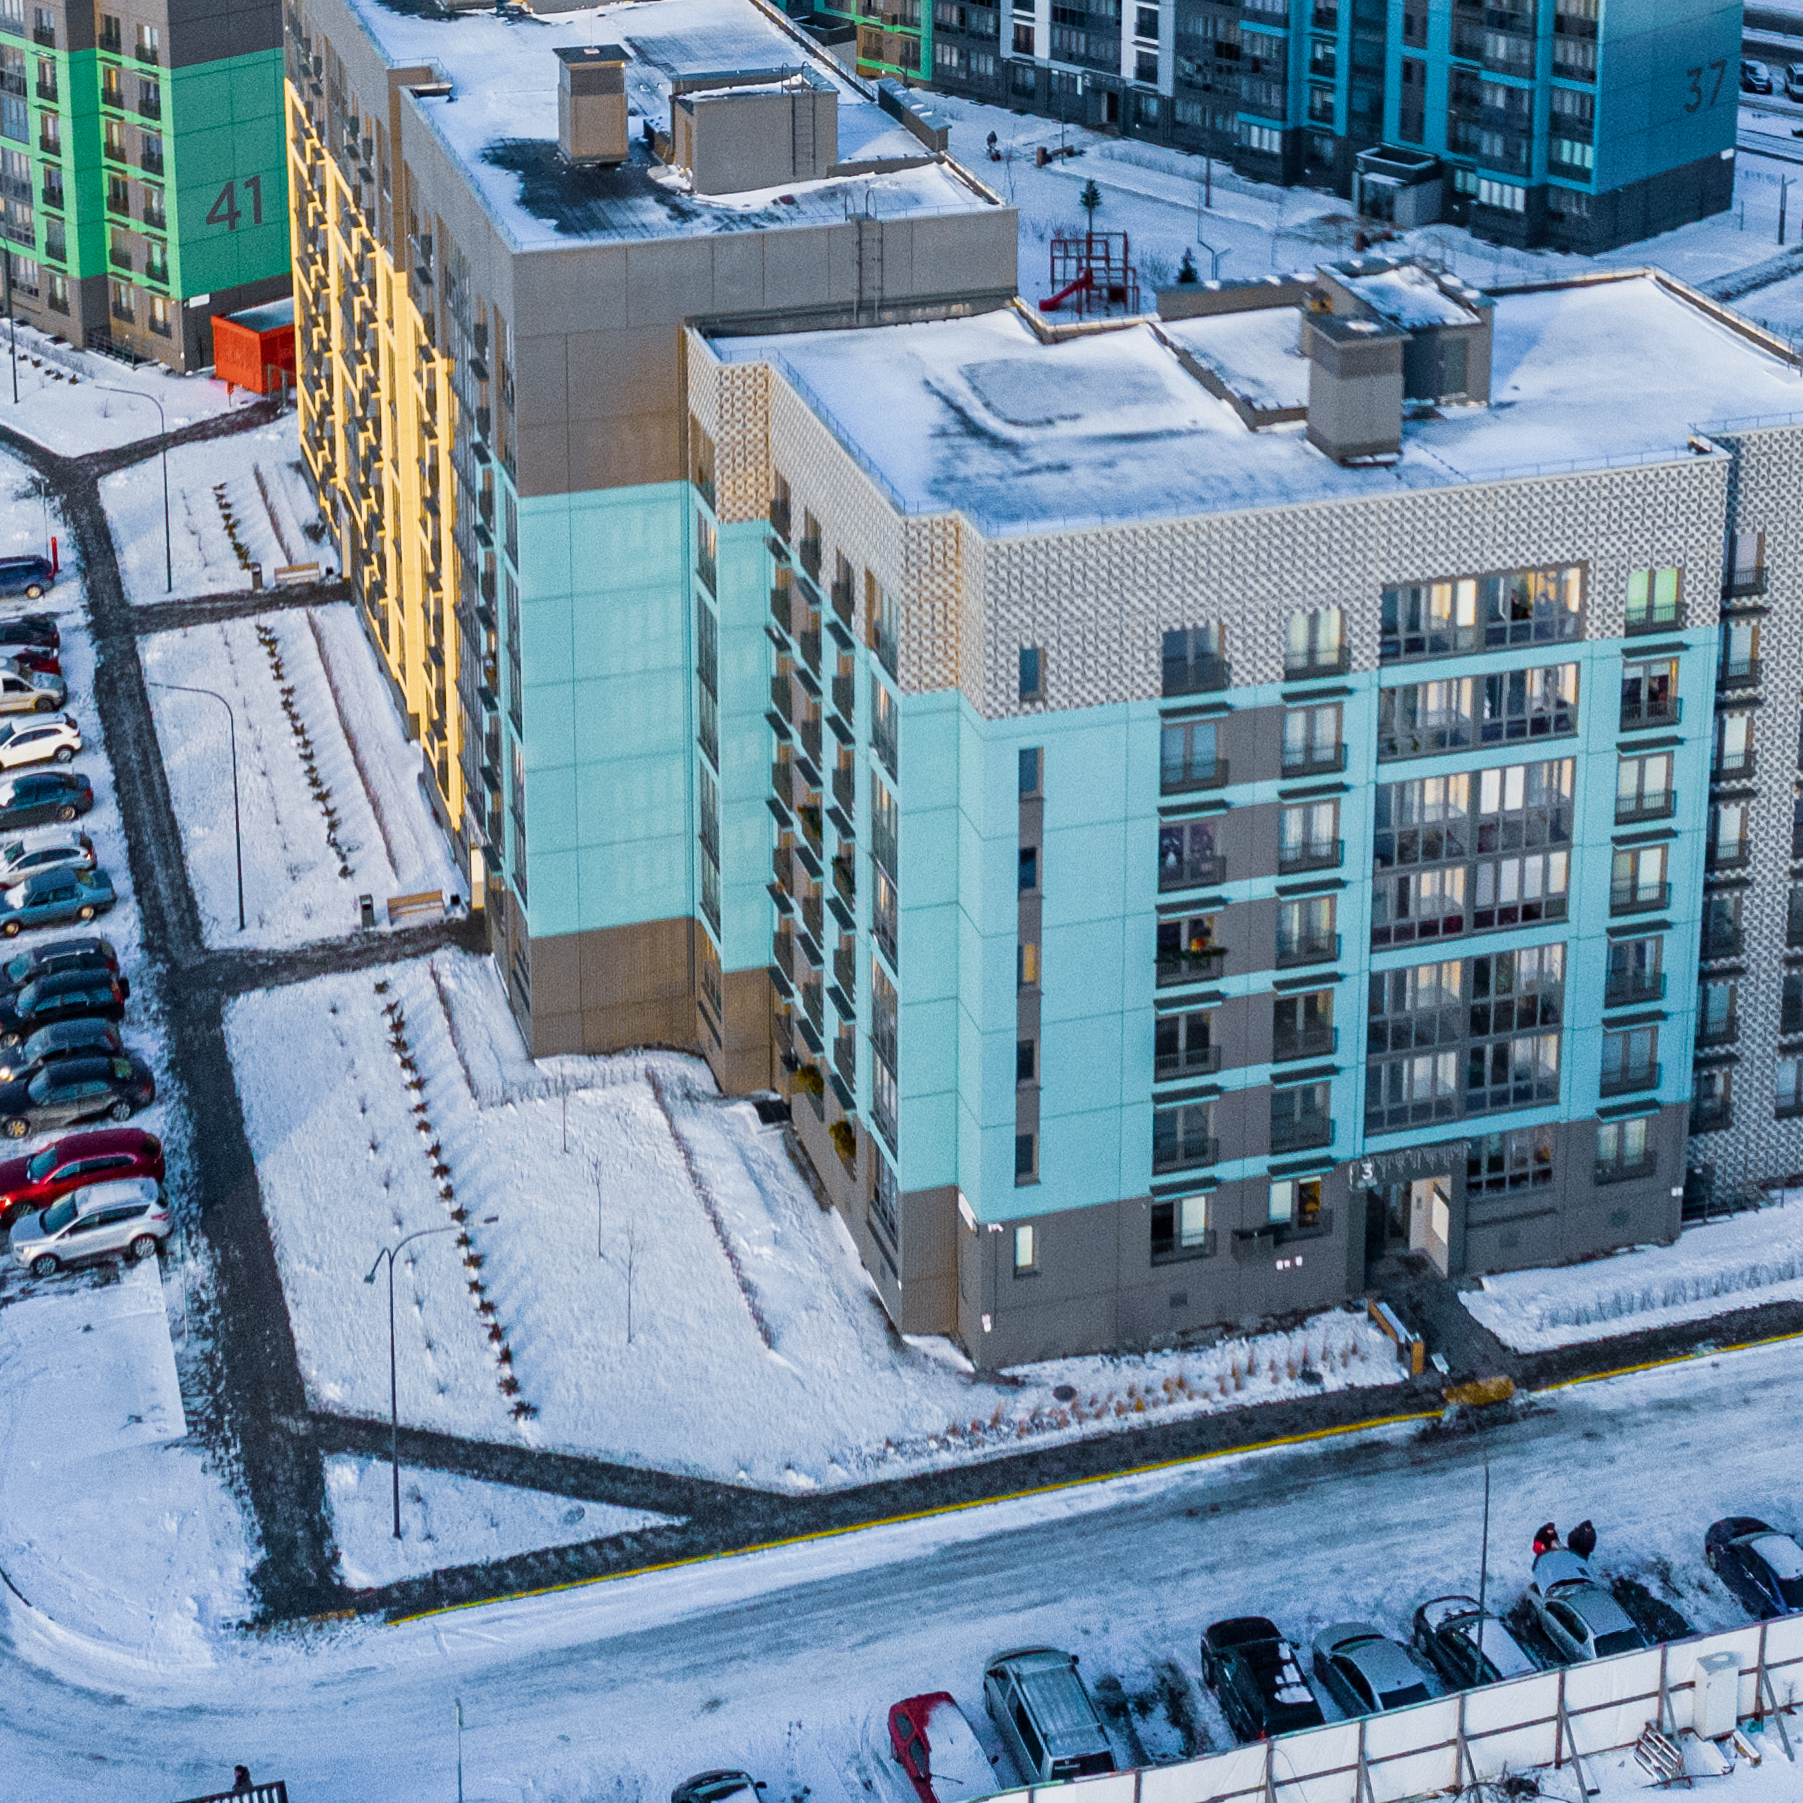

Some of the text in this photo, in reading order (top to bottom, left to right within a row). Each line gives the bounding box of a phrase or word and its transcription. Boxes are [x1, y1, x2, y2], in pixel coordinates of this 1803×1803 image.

[1683, 59, 1727, 113] 37
[206, 175, 262, 230] 41
[1362, 1162, 1373, 1180] 3
